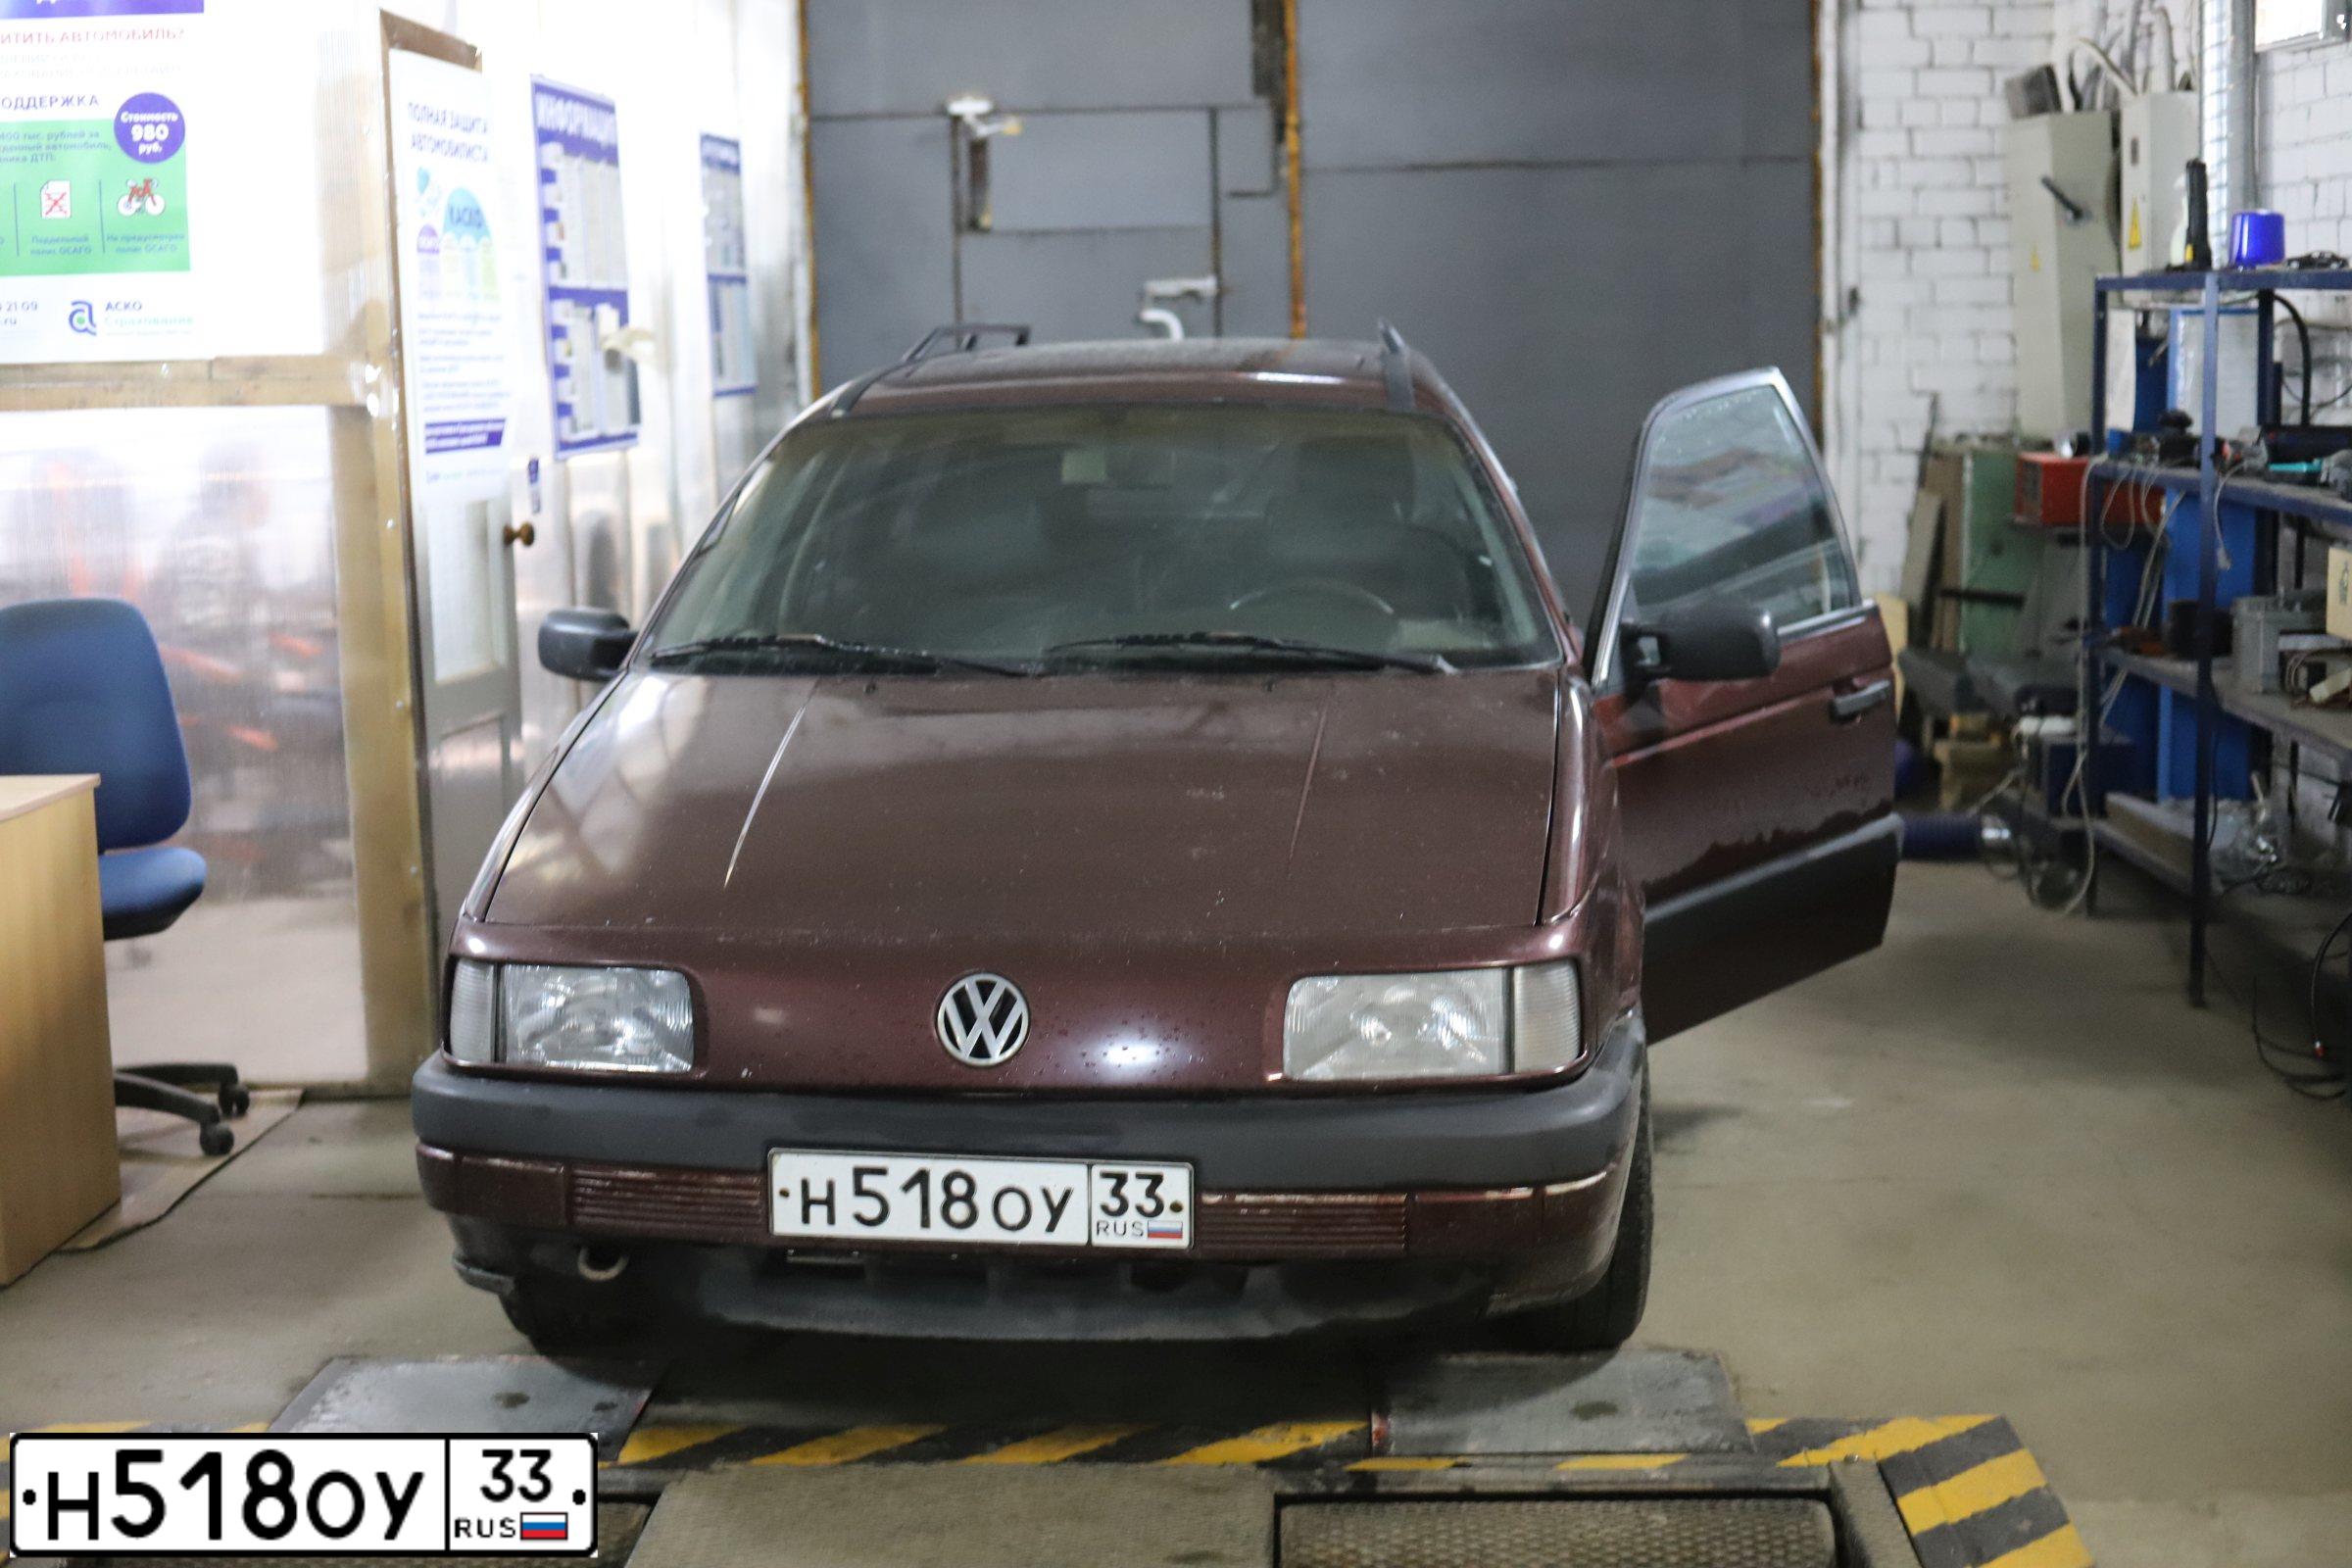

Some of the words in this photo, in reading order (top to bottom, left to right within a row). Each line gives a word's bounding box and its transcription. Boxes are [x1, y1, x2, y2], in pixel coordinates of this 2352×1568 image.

[131, 123, 170, 141] 980
[105, 300, 143, 313] АСКО
[1099, 1170, 1165, 1218] 33
[1096, 1219, 1145, 1238] RUS
